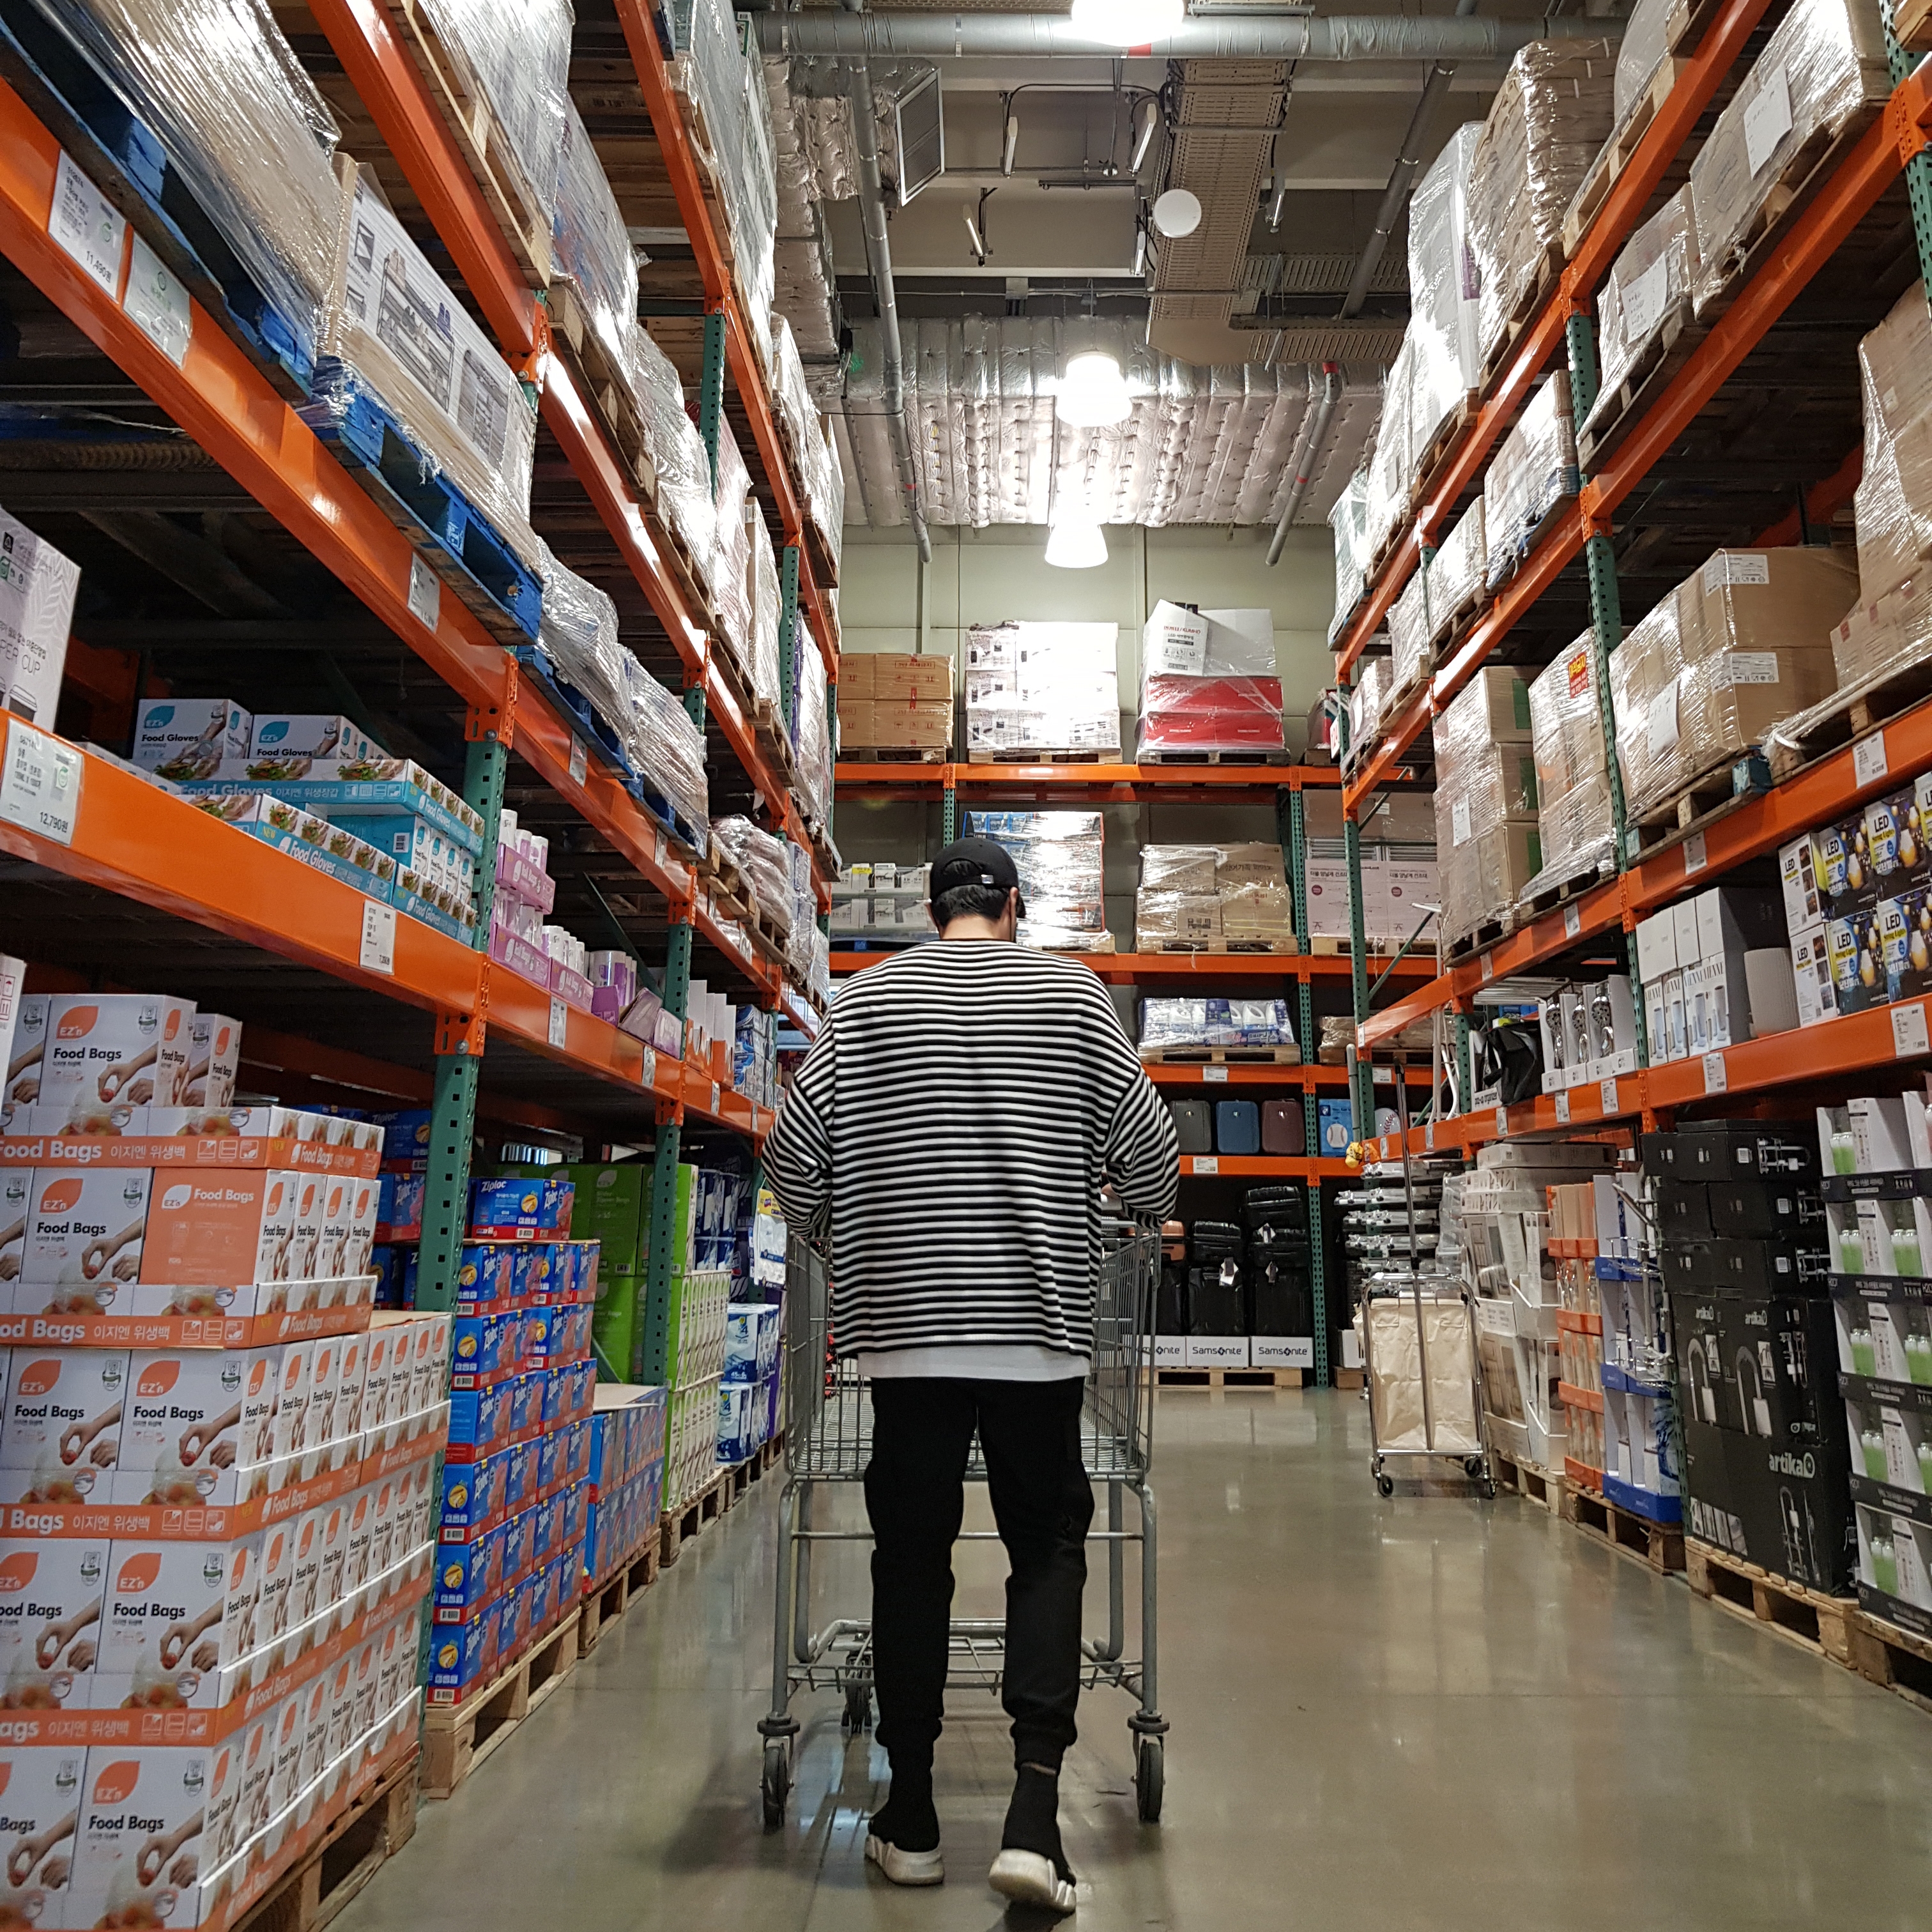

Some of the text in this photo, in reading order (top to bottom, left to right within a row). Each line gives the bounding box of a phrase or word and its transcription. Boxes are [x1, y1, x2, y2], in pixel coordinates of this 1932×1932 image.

[22, 654, 40, 676] CUP
[257, 748, 312, 757] Food Gloves
[181, 784, 272, 796] Food Gloves
[425, 799, 451, 829] Food Gloves
[1874, 815, 1889, 833] LED
[1826, 839, 1839, 857] LED
[289, 840, 336, 875] Food Gloves
[1785, 857, 1795, 872] LED
[413, 898, 441, 926] Food Gloves
[1885, 913, 1901, 931] LED
[1837, 932, 1851, 950] LED
[1797, 946, 1808, 962] LED
[54, 1047, 122, 1061] Food Bags
[161, 1048, 185, 1066] Food Bags
[212, 1062, 232, 1079] Food Bags
[372, 1111, 398, 1124] Ziploc
[50, 1140, 102, 1163] Bags
[300, 1145, 318, 1163] Food
[317, 1147, 334, 1169] Bags
[481, 1179, 506, 1192] Ziploc
[194, 1188, 255, 1204] Food Bags
[37, 1222, 107, 1237] Food Bags
[263, 1225, 286, 1239] Food Bags
[297, 1225, 316, 1238] Food Bags
[324, 1225, 345, 1239] Food Bags
[352, 1226, 371, 1239] Food Bags
[0, 1319, 85, 1342] od Bags
[94, 1324, 170, 1340] 이지엔 위생백
[1192, 1346, 1241, 1356] Samsonite
[1258, 1346, 1308, 1356] Samsonite
[15, 1405, 84, 1420] Food Bags
[134, 1406, 204, 1422] Food Bags
[245, 1403, 270, 1418] Food Bags
[1768, 1452, 1805, 1478] artika
[271, 1488, 308, 1515] Food Bags
[11, 1508, 64, 1535] Bags
[72, 1515, 150, 1533] 이지엔 위생백
[0, 1602, 63, 1619] ood Bags
[114, 1602, 186, 1620] Food Bags
[0, 1721, 39, 1744] ags
[0, 1817, 35, 1834] Bags
[88, 1815, 165, 1833] Food Bags
